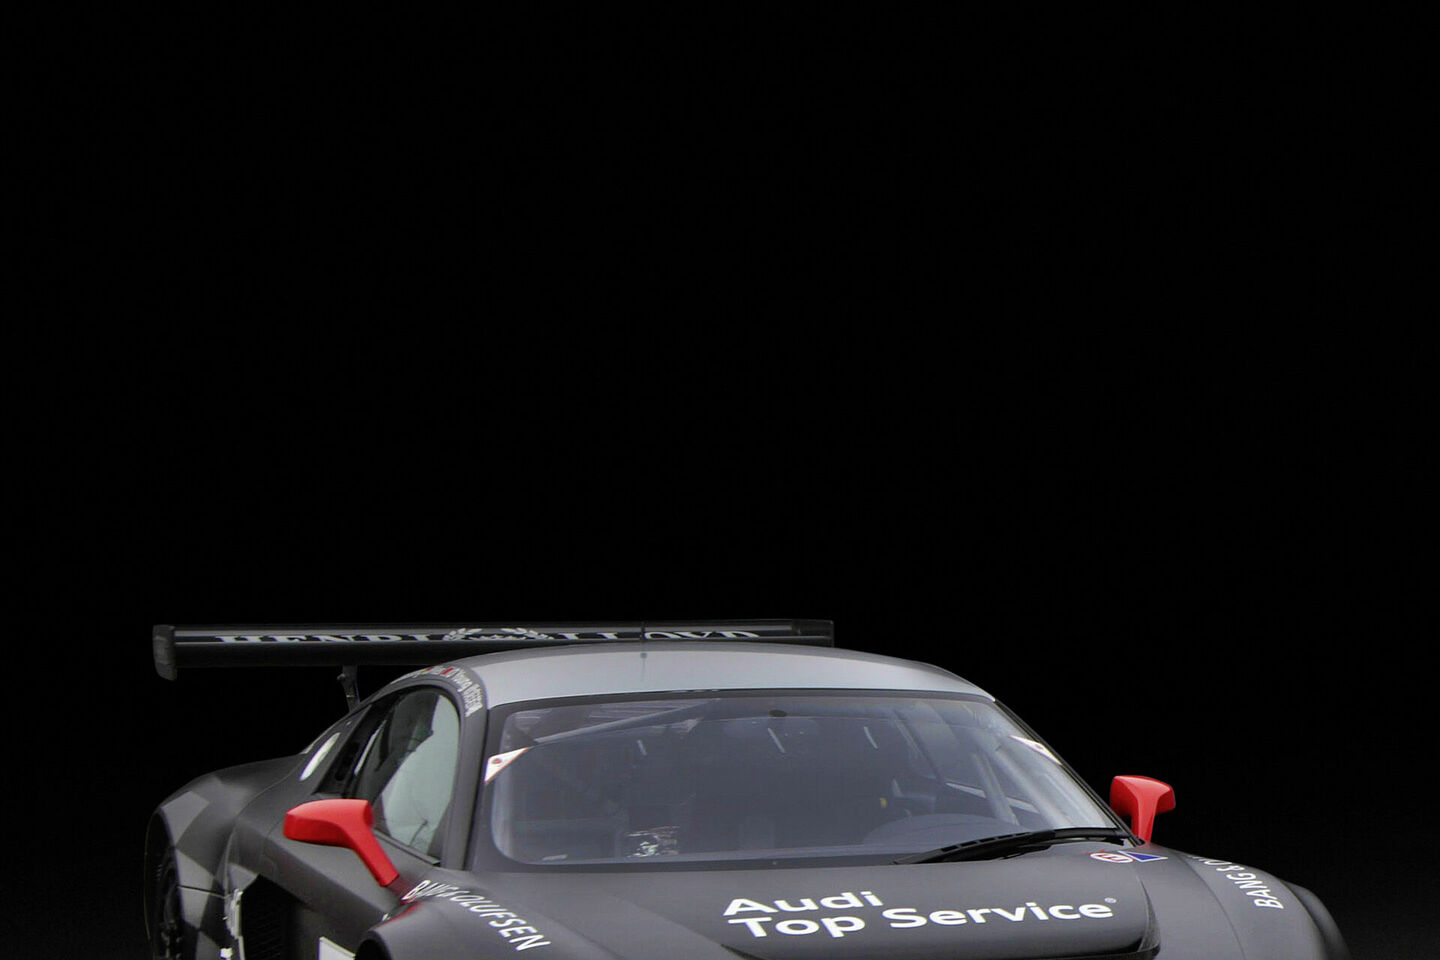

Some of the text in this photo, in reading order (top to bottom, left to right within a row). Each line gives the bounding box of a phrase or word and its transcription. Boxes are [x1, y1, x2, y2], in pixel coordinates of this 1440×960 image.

[722, 891, 884, 916] Audi
[1226, 872, 1284, 909] BANG
[450, 894, 551, 951] OLUFSEN
[728, 902, 1114, 938] Top Service
